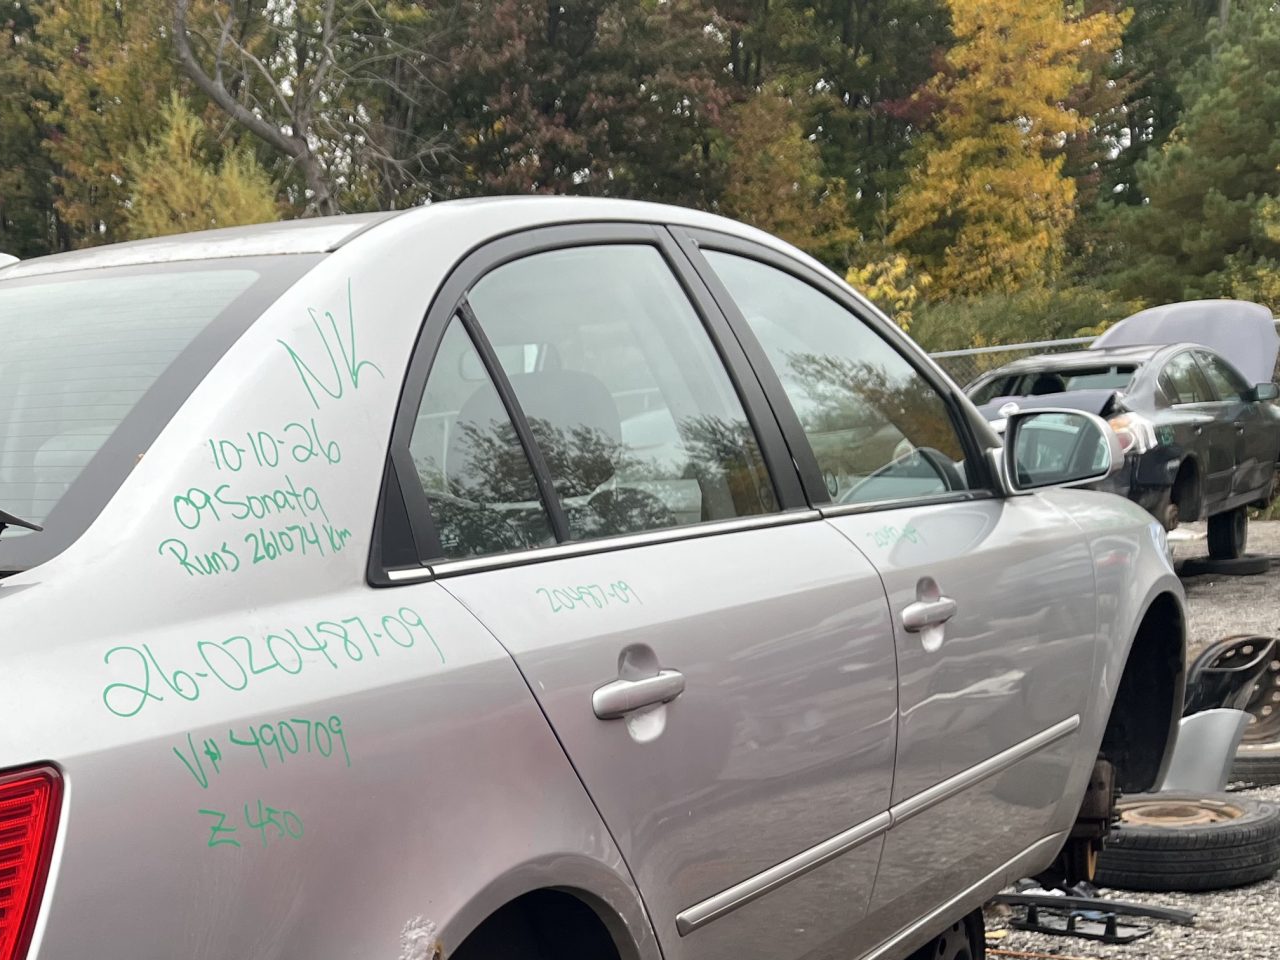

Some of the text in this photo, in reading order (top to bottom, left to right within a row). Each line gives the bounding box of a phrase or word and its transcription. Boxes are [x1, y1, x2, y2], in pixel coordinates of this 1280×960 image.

[208, 417, 342, 472] 10-10-26
[158, 537, 240, 576] Runs
[244, 521, 325, 565] 261074
[102, 606, 446, 718] 26-020487-09
[228, 715, 352, 769] 490709
[243, 799, 306, 849] 450
